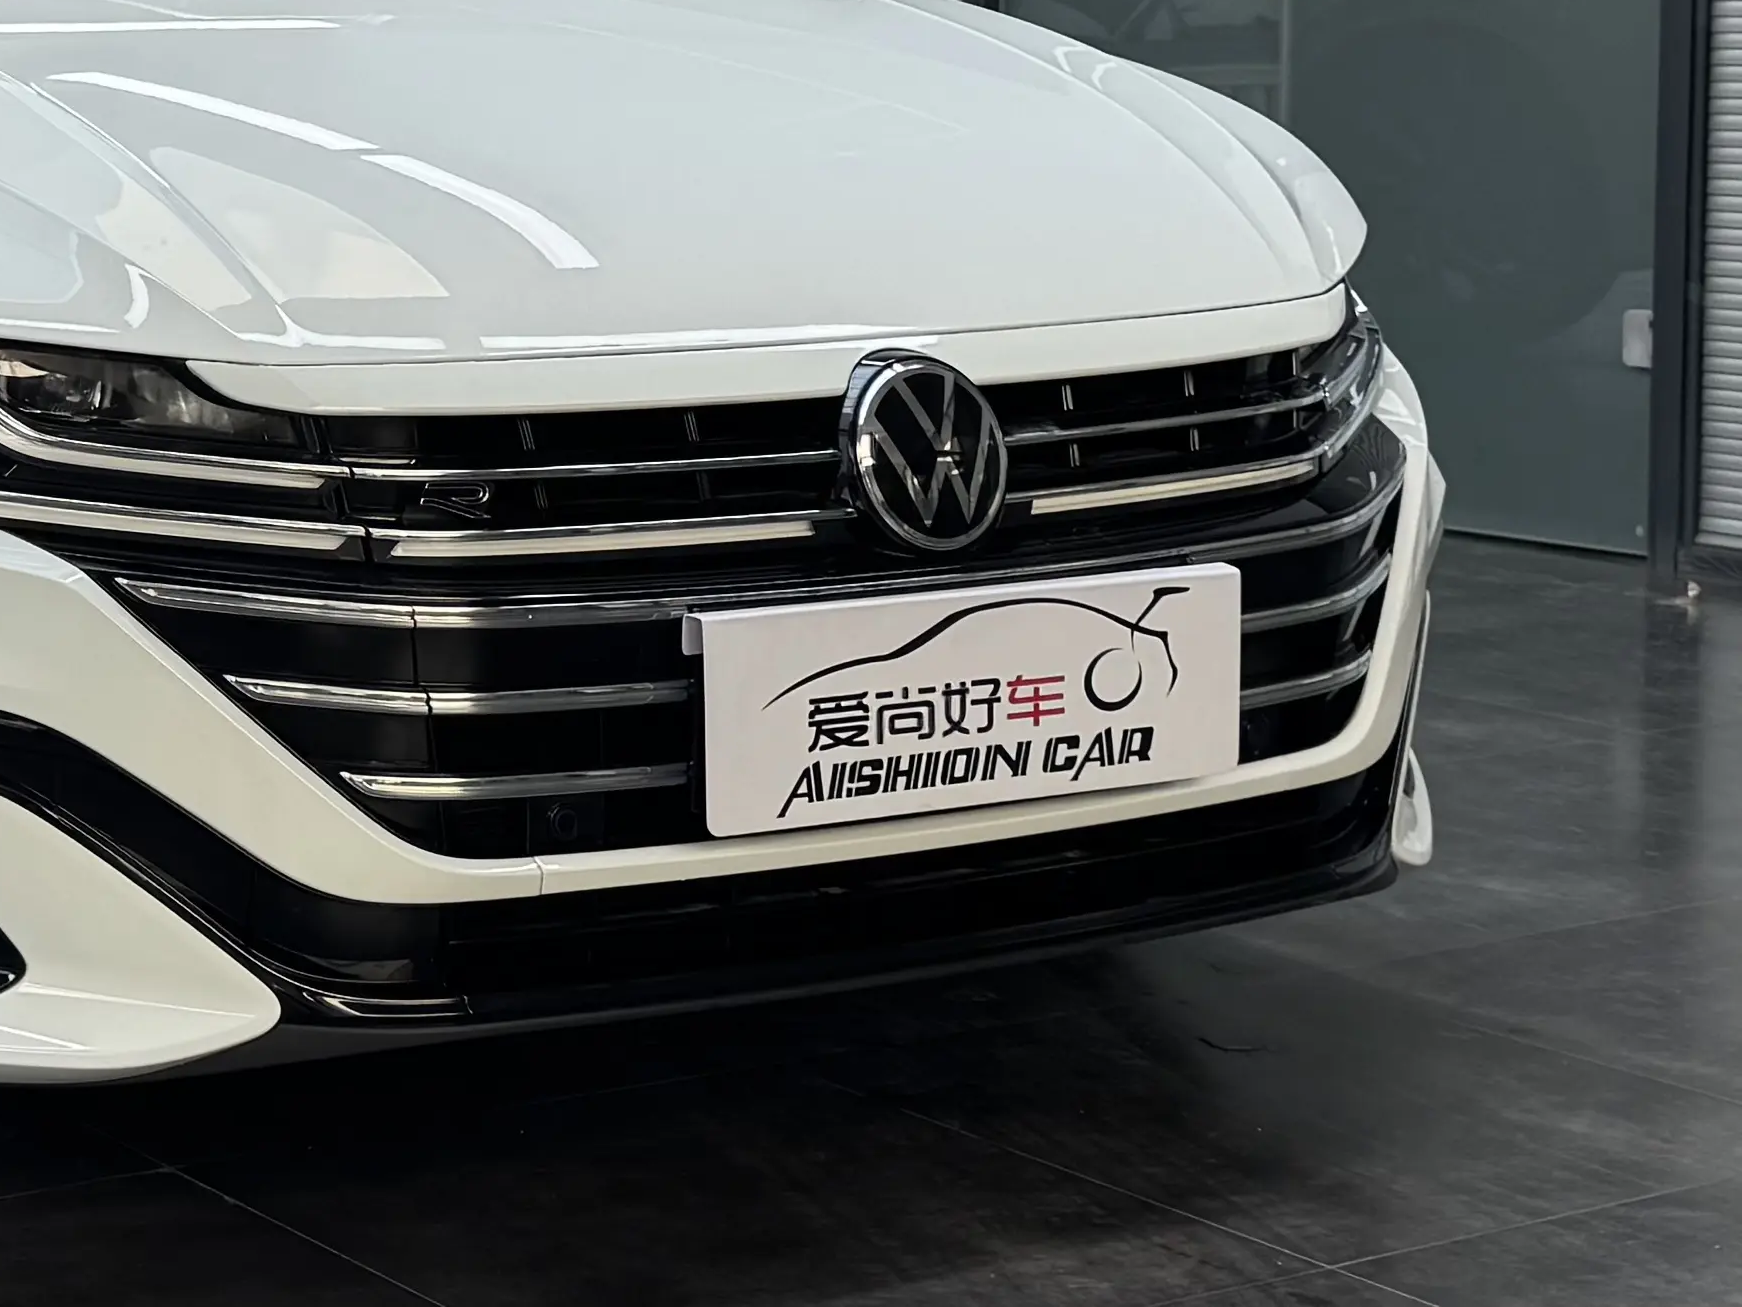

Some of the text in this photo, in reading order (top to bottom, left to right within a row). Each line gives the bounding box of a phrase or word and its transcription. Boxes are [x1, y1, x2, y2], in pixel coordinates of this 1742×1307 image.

[807, 674, 1066, 753] 爱尚好车
[1041, 725, 1155, 782] CAR
